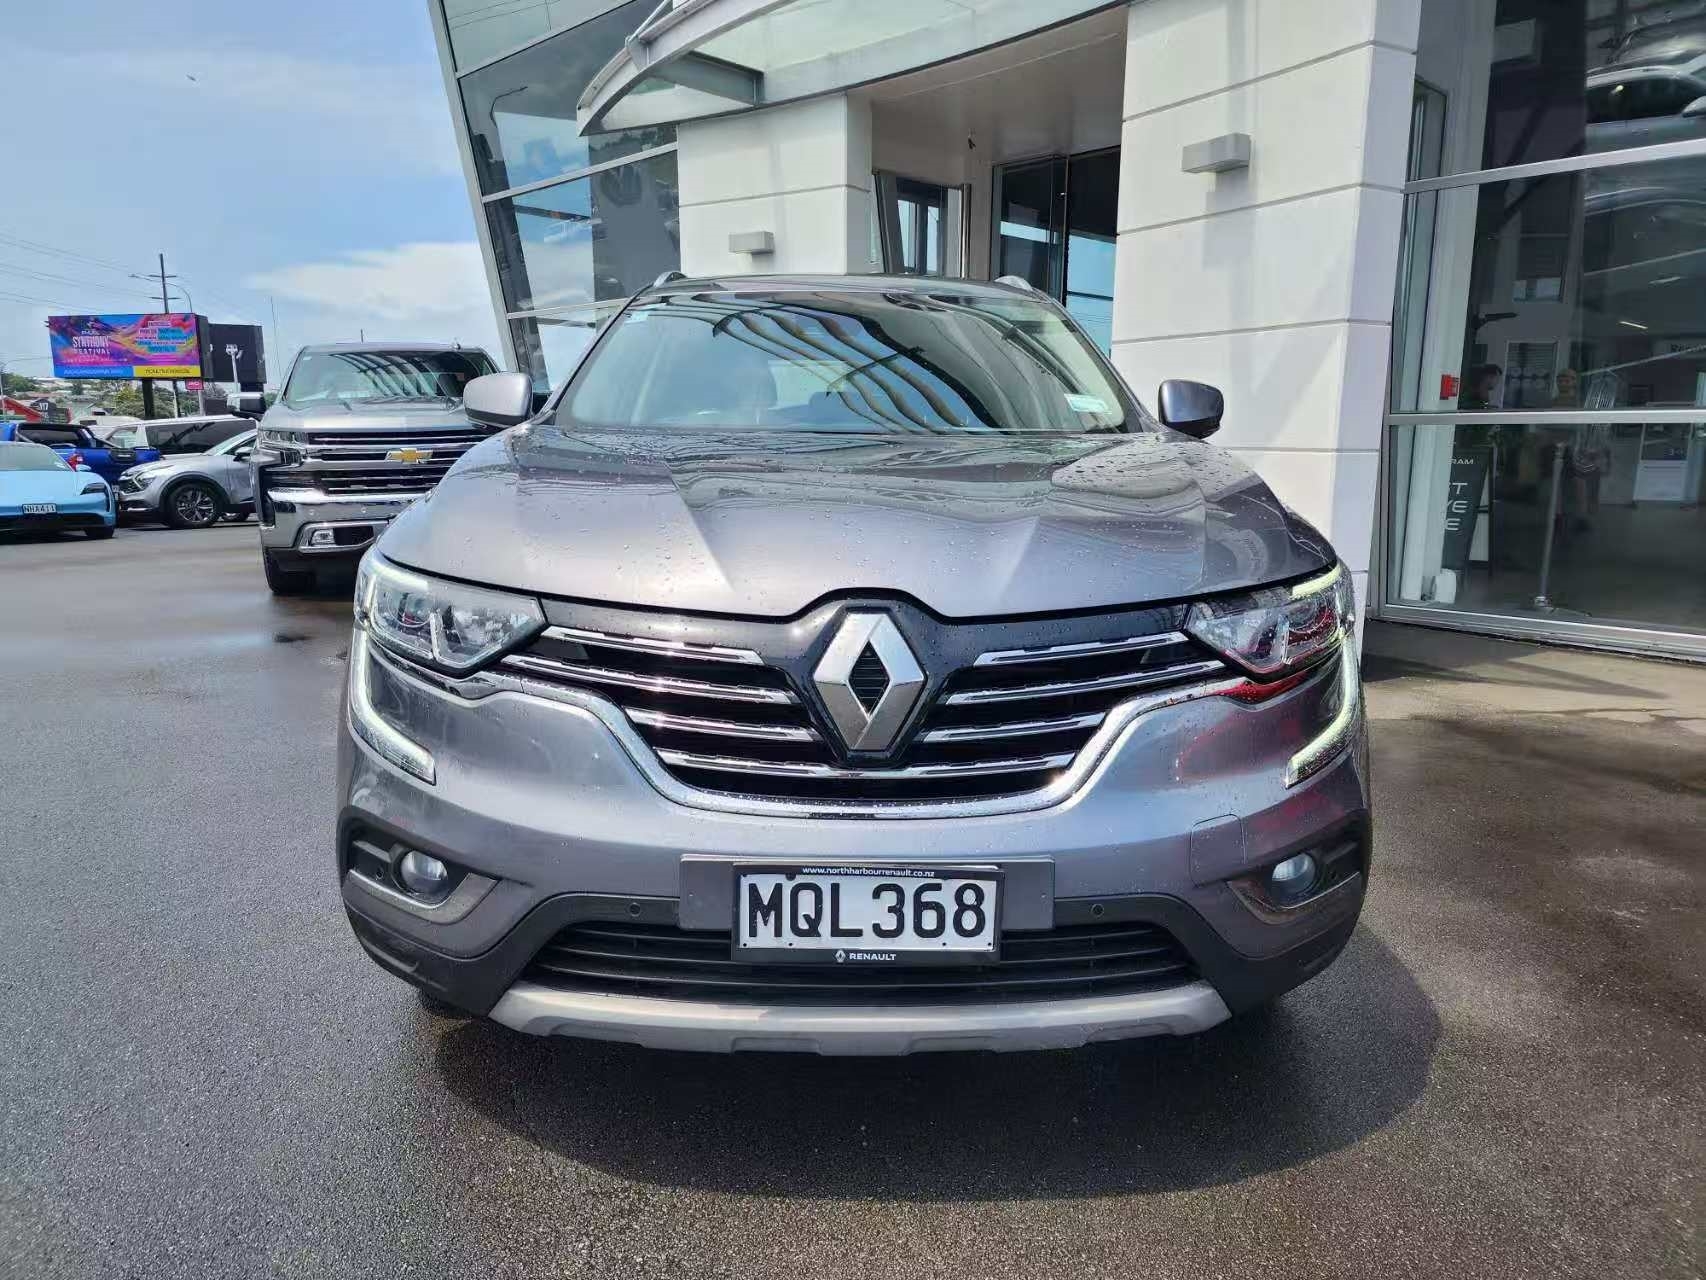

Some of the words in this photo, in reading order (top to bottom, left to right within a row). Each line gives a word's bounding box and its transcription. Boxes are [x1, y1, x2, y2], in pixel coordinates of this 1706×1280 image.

[802, 866, 935, 878] www.northharbourrenault.co.nz
[748, 882, 987, 939] MQL368
[849, 953, 897, 961] RENAULT
